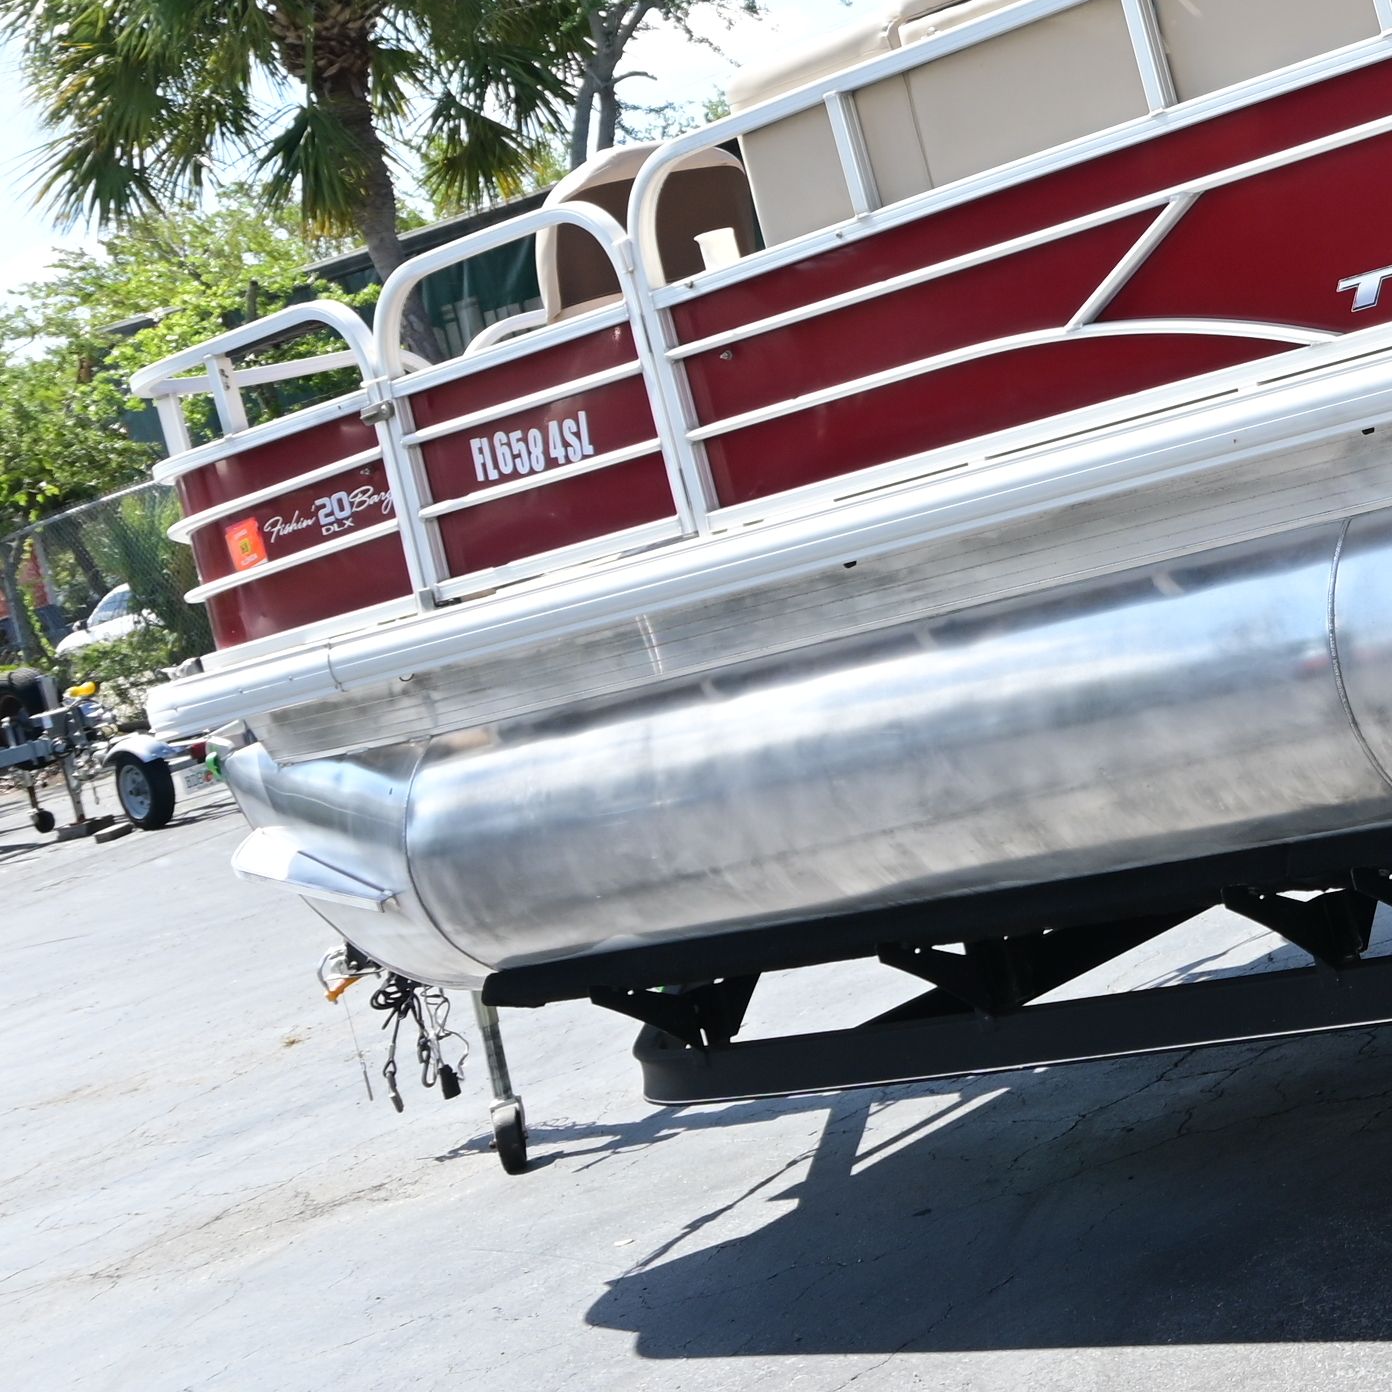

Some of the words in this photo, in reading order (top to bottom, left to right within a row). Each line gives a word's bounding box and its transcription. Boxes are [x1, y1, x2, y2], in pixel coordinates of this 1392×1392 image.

[314, 490, 351, 526] 20
[349, 485, 396, 515] Barg
[321, 517, 355, 536] DLX
